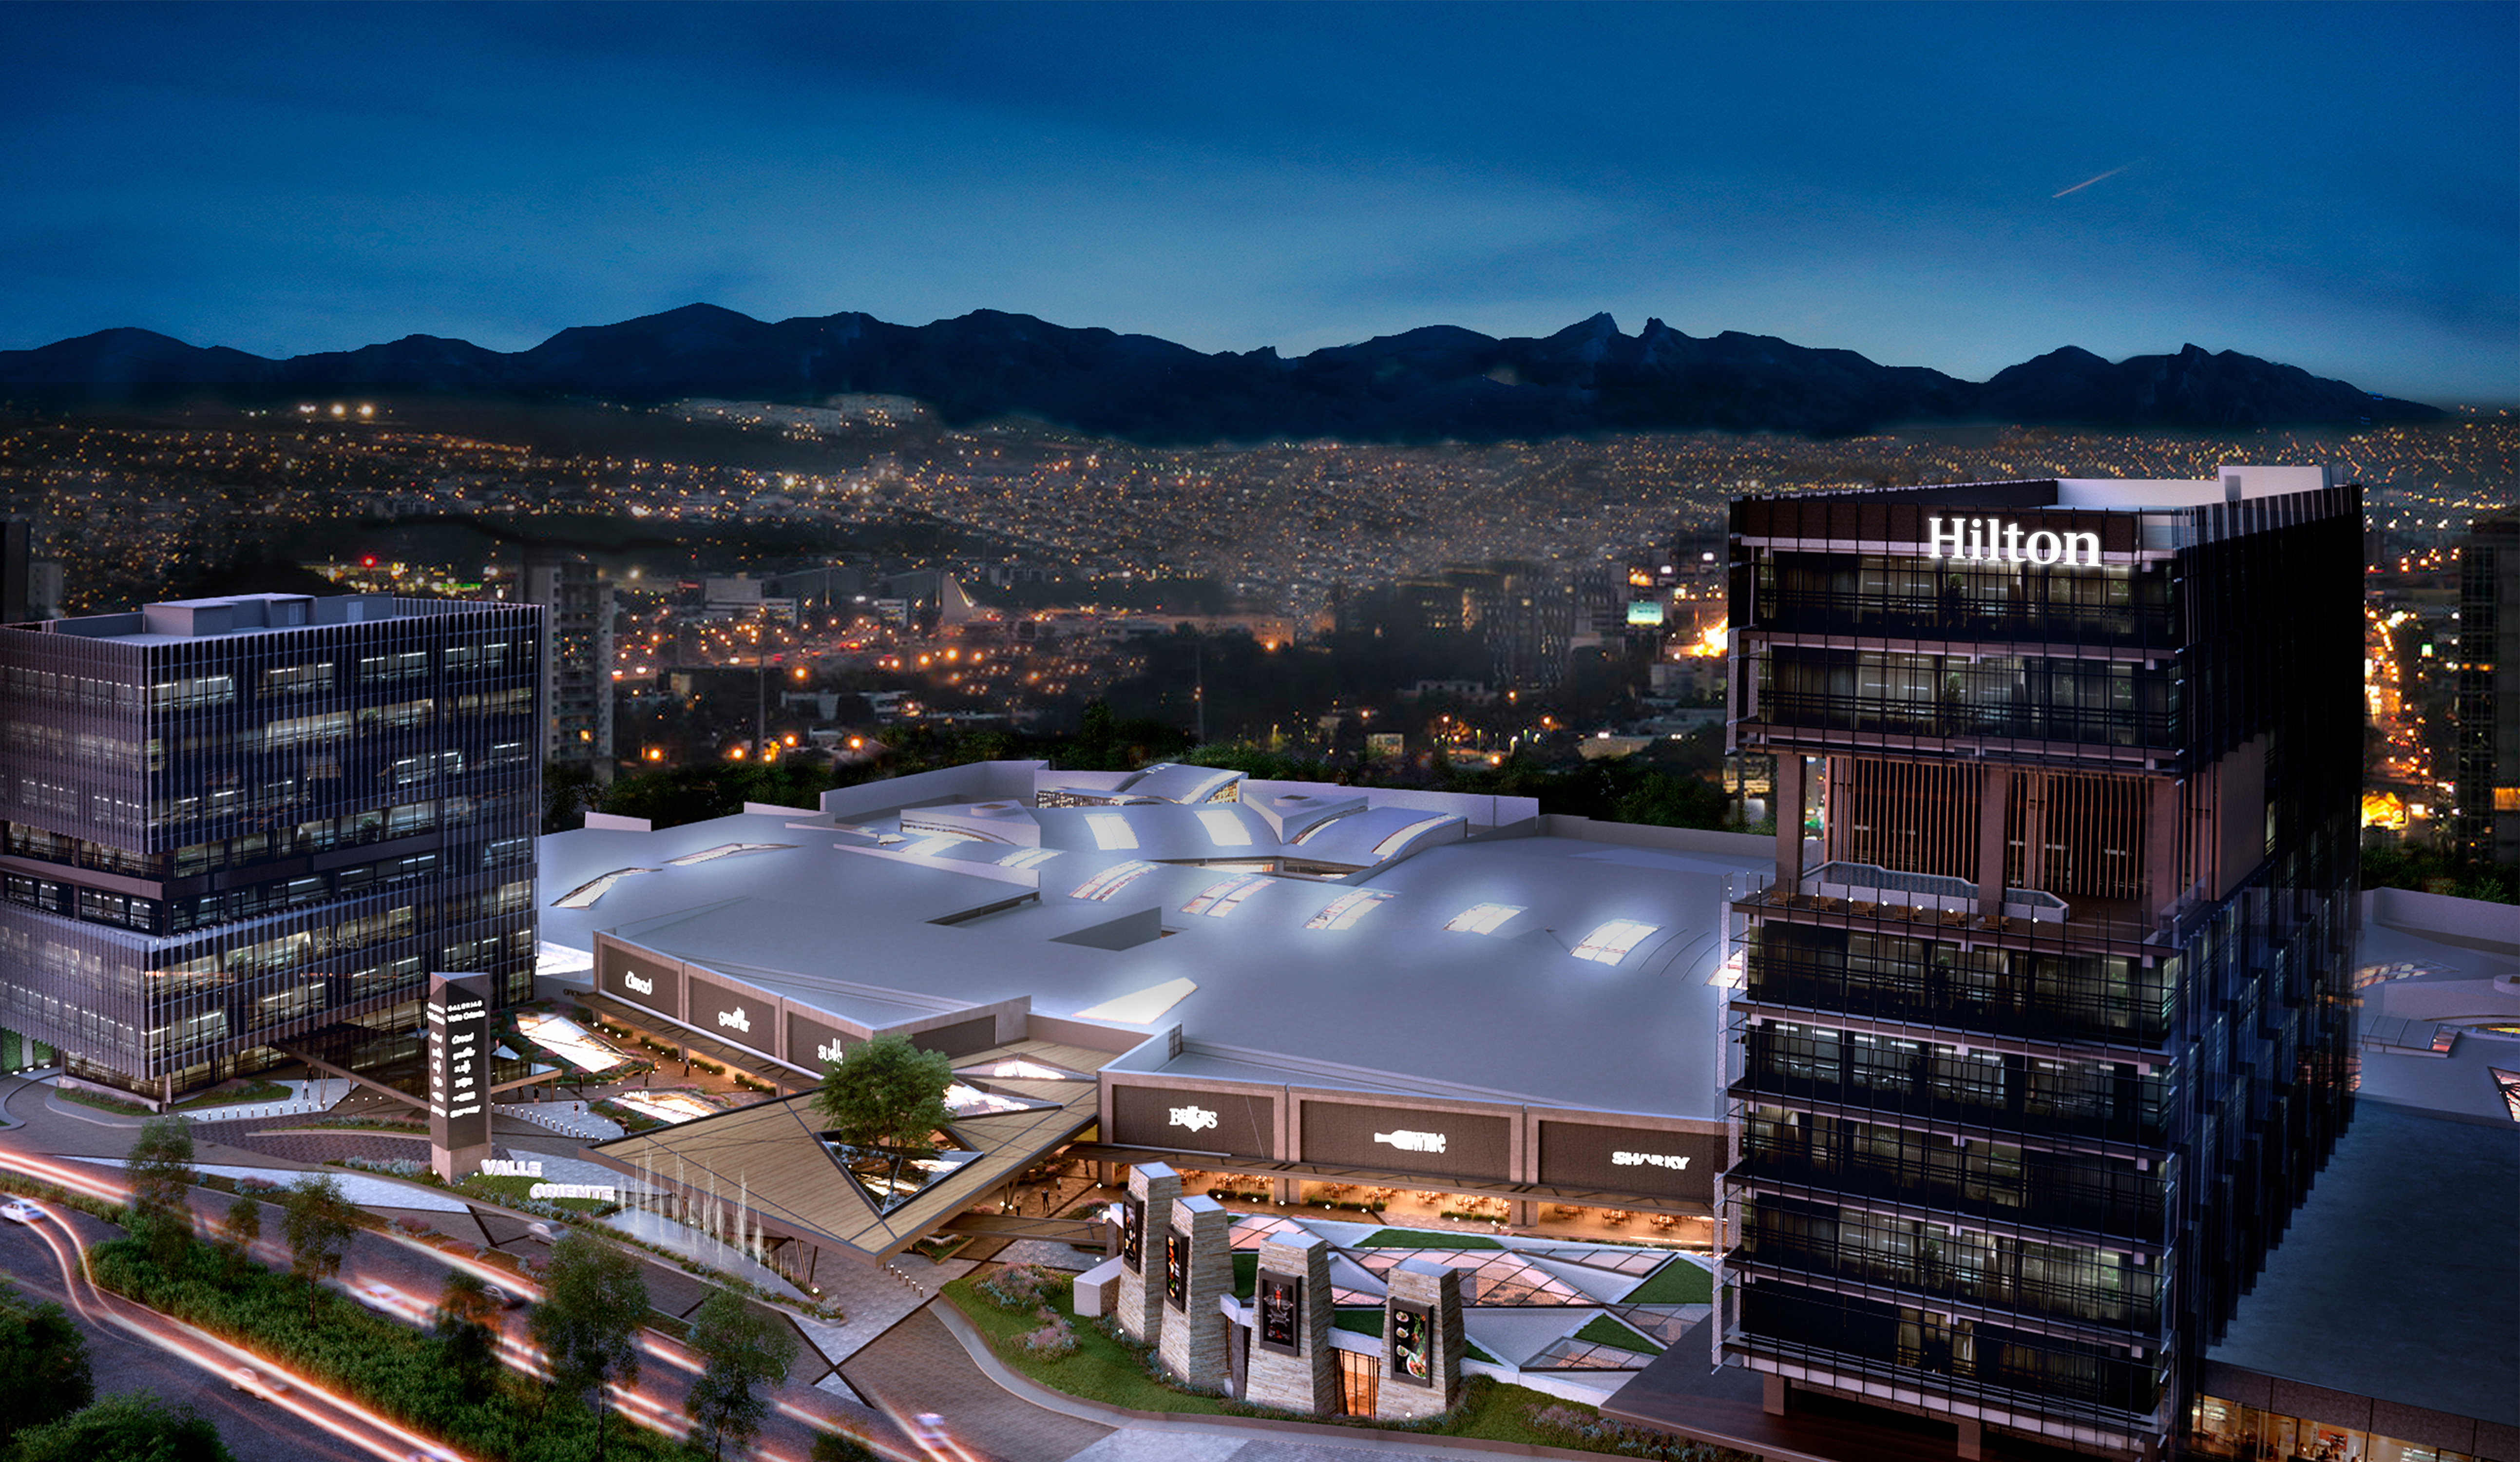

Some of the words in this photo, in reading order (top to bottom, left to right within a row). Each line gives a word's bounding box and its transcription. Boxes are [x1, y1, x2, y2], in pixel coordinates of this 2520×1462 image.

[1928, 517, 2102, 567] Hilton
[480, 1159, 542, 1177] VALLE
[1611, 1151, 1690, 1170] SHARKY
[529, 1183, 615, 1202] ORIENTE
